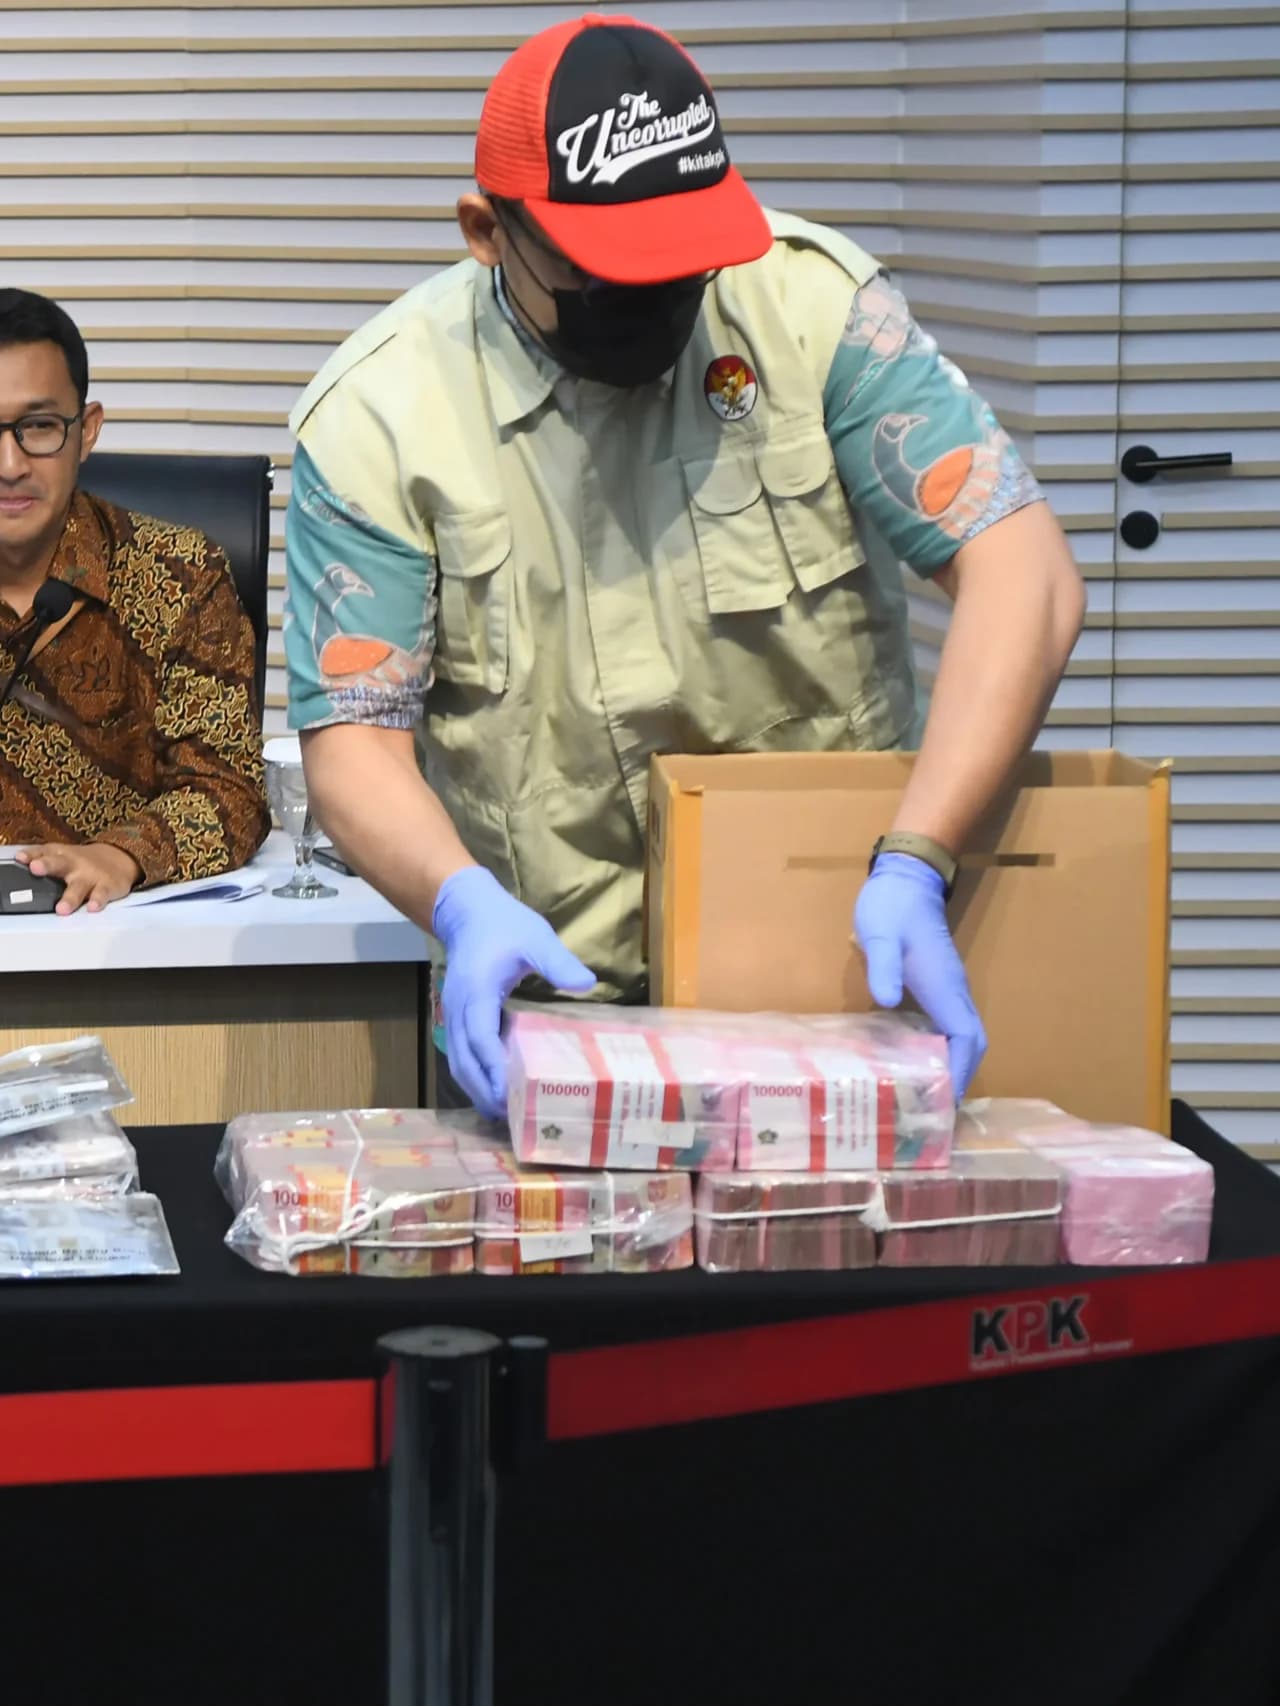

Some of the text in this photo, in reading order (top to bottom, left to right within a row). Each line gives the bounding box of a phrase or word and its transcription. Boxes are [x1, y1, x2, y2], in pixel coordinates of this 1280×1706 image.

[618, 91, 660, 128] The
[556, 94, 712, 183] Uncorrupted
[540, 1083, 590, 1097] 100000
[753, 1085, 803, 1098] 100000
[971, 1294, 1089, 1357] KPK
